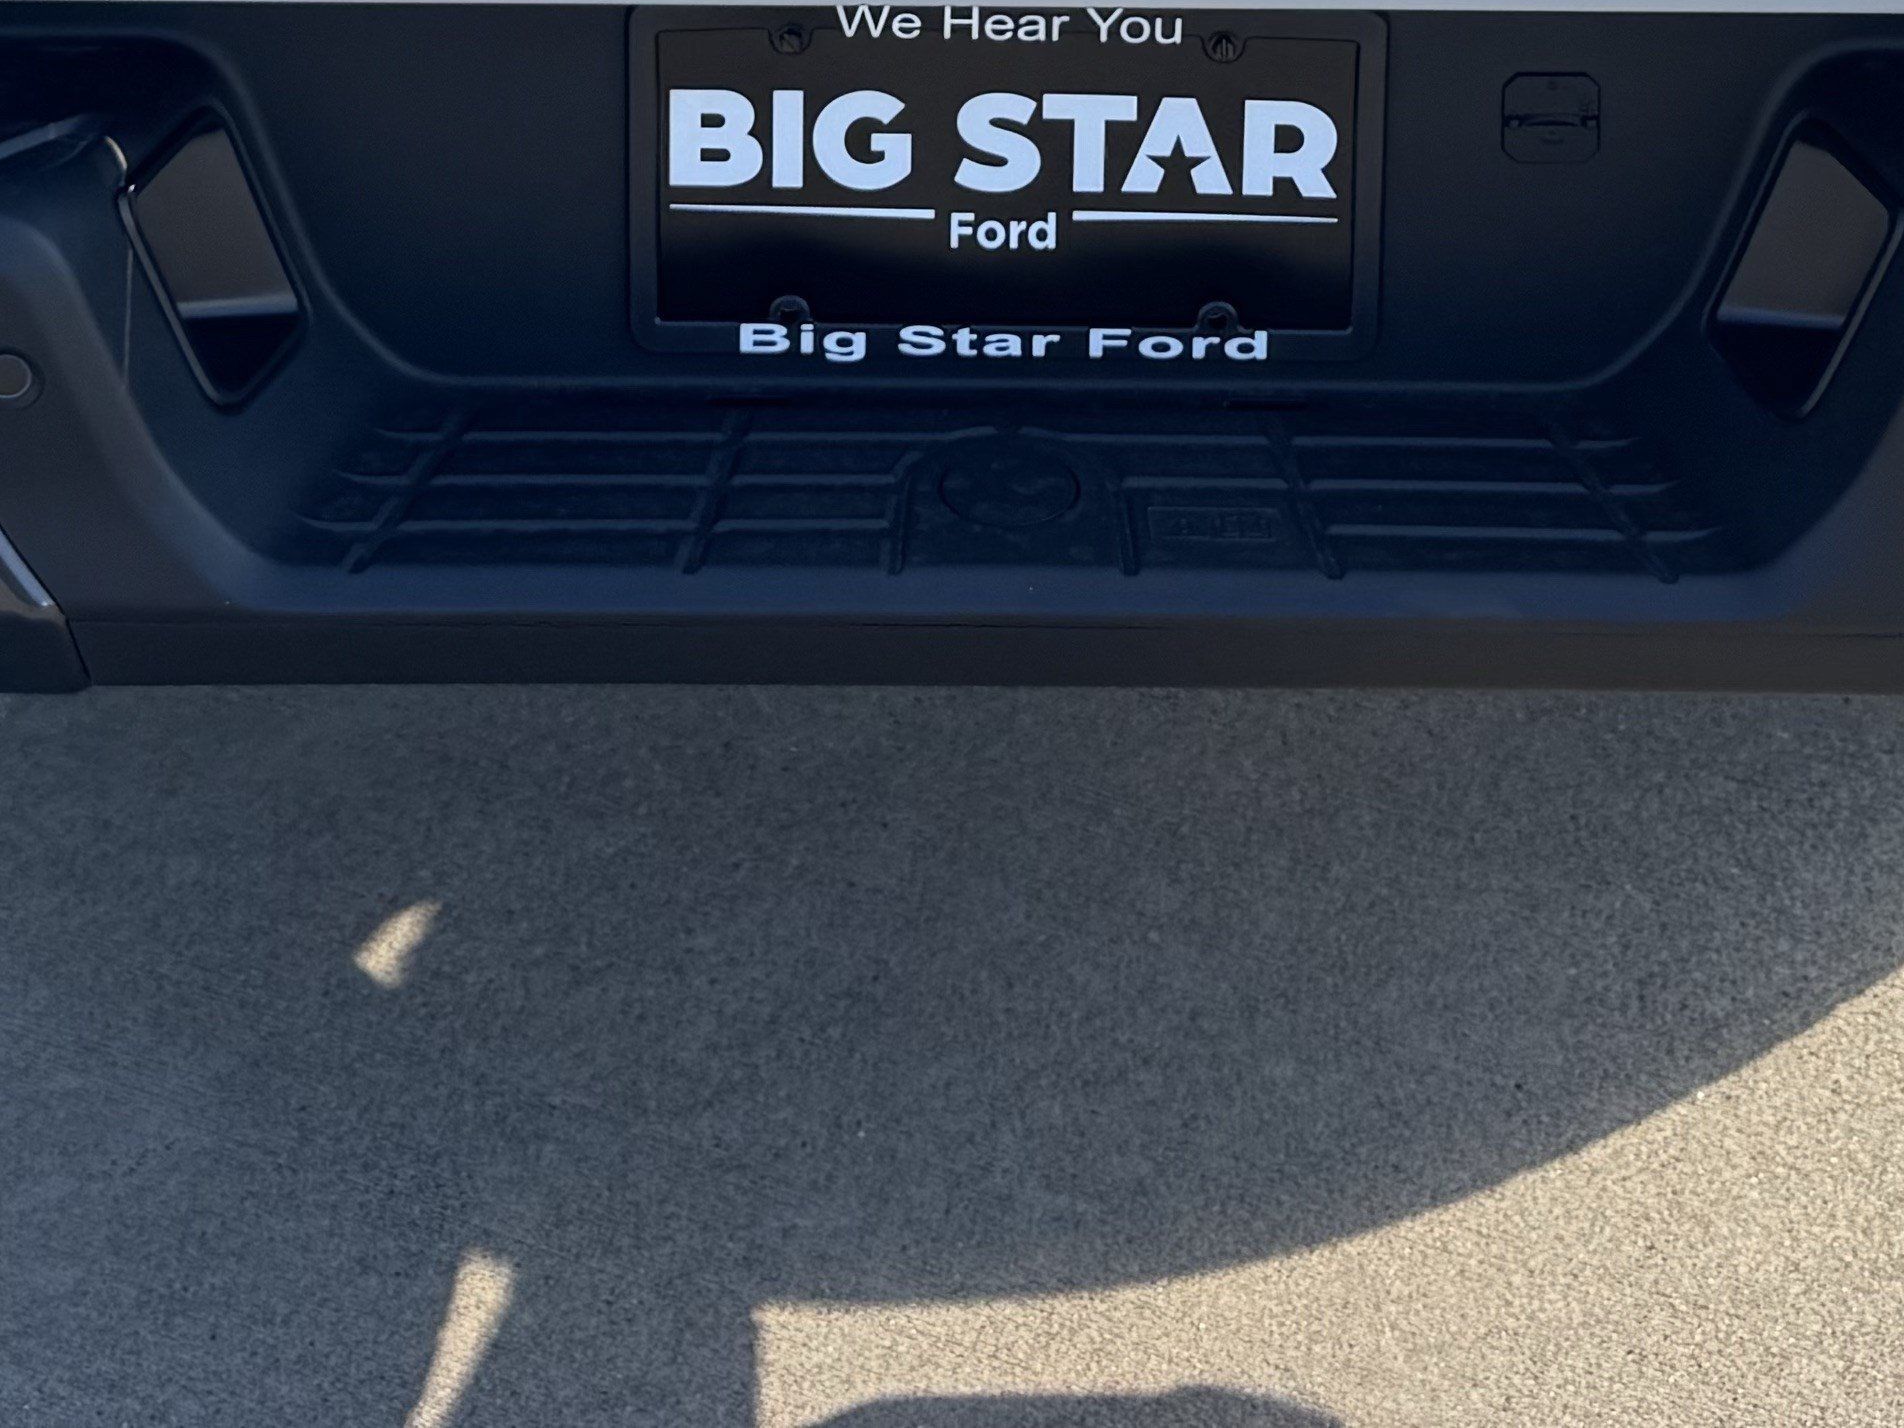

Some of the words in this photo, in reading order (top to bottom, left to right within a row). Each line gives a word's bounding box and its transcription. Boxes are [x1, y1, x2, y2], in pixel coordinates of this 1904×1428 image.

[835, 4, 922, 40] We
[943, 5, 1071, 42] Hear
[1085, 7, 1183, 45] You
[667, 88, 913, 192] BIG
[953, 93, 1338, 200] STAR
[949, 211, 1058, 251] Ford
[738, 322, 867, 363] Big
[897, 324, 1060, 360] Star
[1087, 327, 1270, 361] Ford
